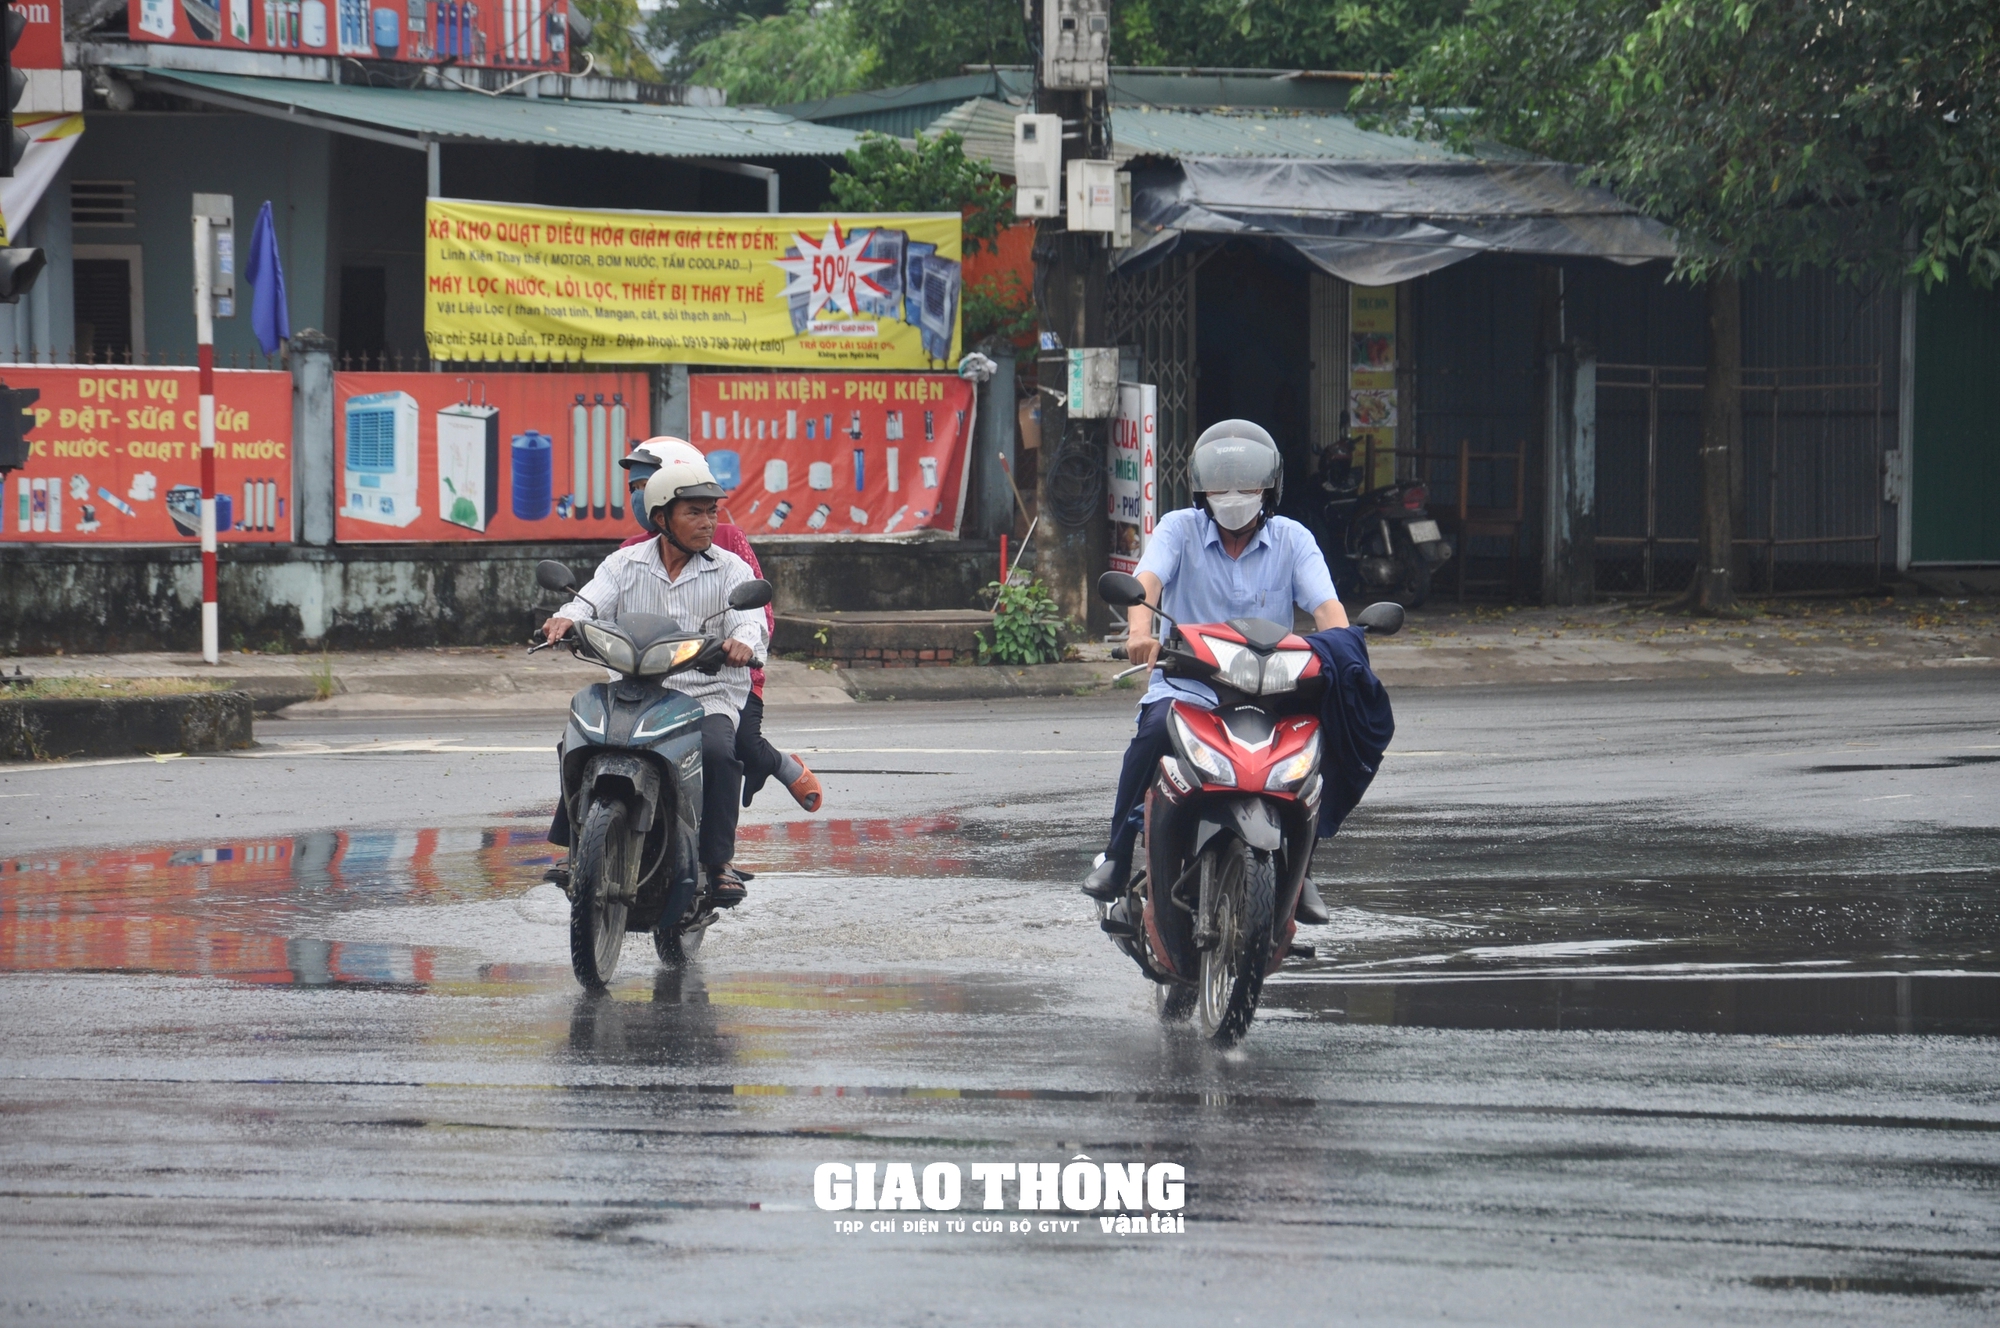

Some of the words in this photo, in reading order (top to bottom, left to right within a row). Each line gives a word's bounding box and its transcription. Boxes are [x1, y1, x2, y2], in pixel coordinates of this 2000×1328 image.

[8, 3, 50, 23] om
[456, 220, 491, 242] KHO
[497, 222, 541, 247] QUẠT
[546, 217, 585, 246] ĐIỀU
[591, 222, 625, 247] HÒA
[629, 222, 670, 249] GIẢM
[742, 225, 779, 251] ĐẾN:
[441, 249, 466, 261] Linh
[469, 250, 493, 263] Kiện
[496, 251, 521, 266] Thay
[551, 254, 594, 267] MOTOR,
[813, 254, 857, 294] 50%
[429, 271, 462, 294] MÁY
[468, 275, 499, 298] LỌC
[505, 274, 551, 298] NƯỚC,
[585, 281, 618, 303] LỌC,
[622, 276, 667, 301] THIẾT
[671, 284, 687, 305] BỊ
[692, 285, 731, 304] THAY
[736, 279, 765, 304] THẾ
[437, 303, 456, 316] Vật
[459, 303, 482, 316] Liệu
[485, 303, 505, 317] Lọc
[515, 304, 541, 316] than
[681, 309, 710, 323] thạch
[469, 333, 488, 346] 544
[616, 334, 644, 350] Điện
[683, 335, 709, 349] 0919
[79, 378, 138, 403] DỊCH
[144, 379, 178, 404] VỤ
[718, 380, 769, 402] LINH
[775, 377, 827, 404] KIỆN
[845, 380, 887, 404] PHỤ
[894, 377, 944, 404] KIỆN
[53, 437, 110, 458] NƯỚC
[128, 441, 186, 462] QUẠT
[232, 439, 286, 459] NƯỚC
[1115, 454, 1138, 482] MIẾN
[1123, 491, 1140, 518] PHỞ
[1234, 705, 1266, 715] HONDA
